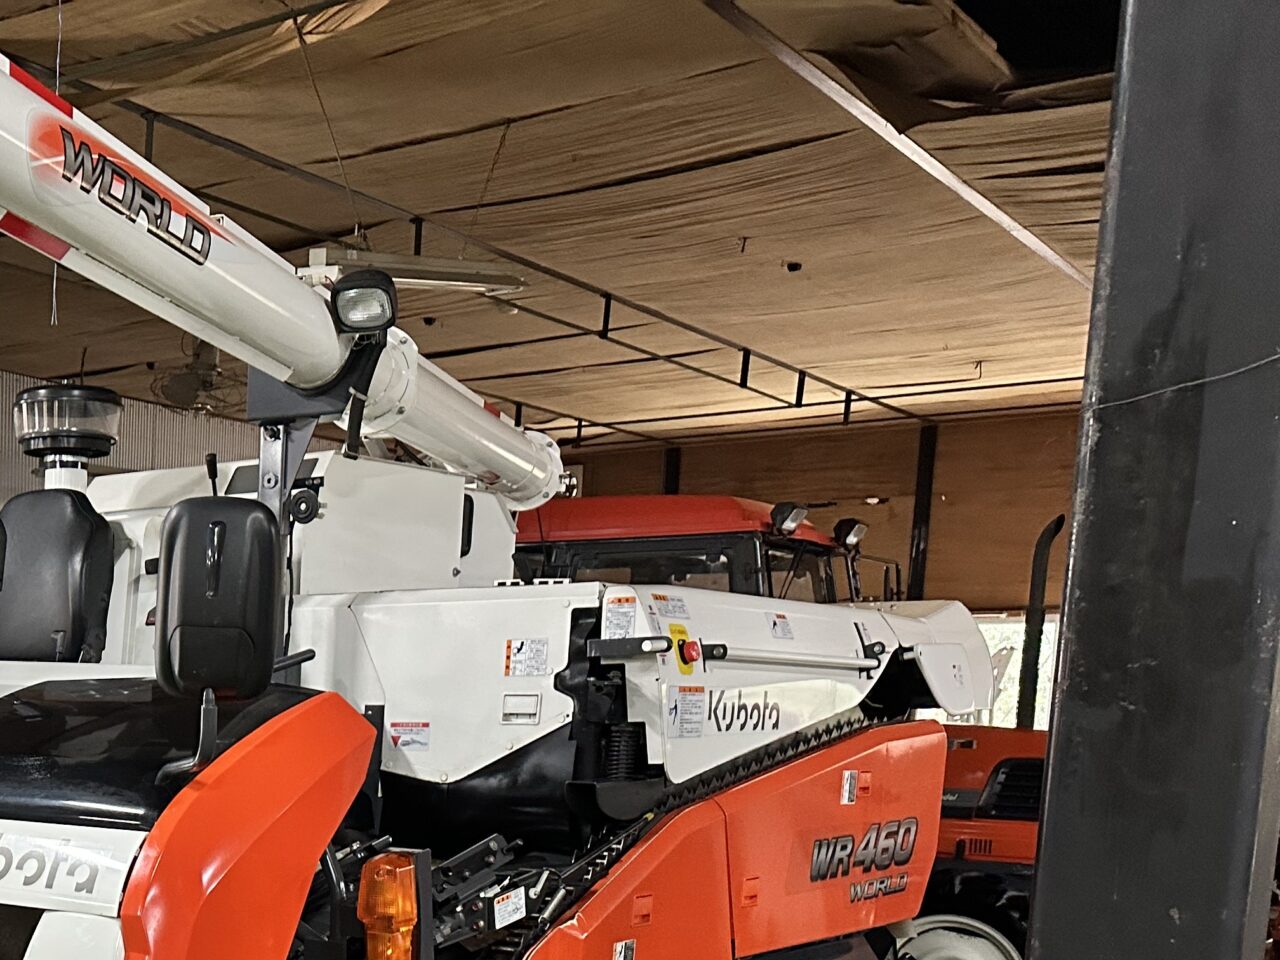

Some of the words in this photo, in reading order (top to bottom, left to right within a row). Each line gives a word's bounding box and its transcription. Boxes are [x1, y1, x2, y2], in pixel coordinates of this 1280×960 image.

[59, 125, 211, 266] WORLD
[707, 690, 780, 732] Kubota
[850, 872, 908, 903] WORLD
